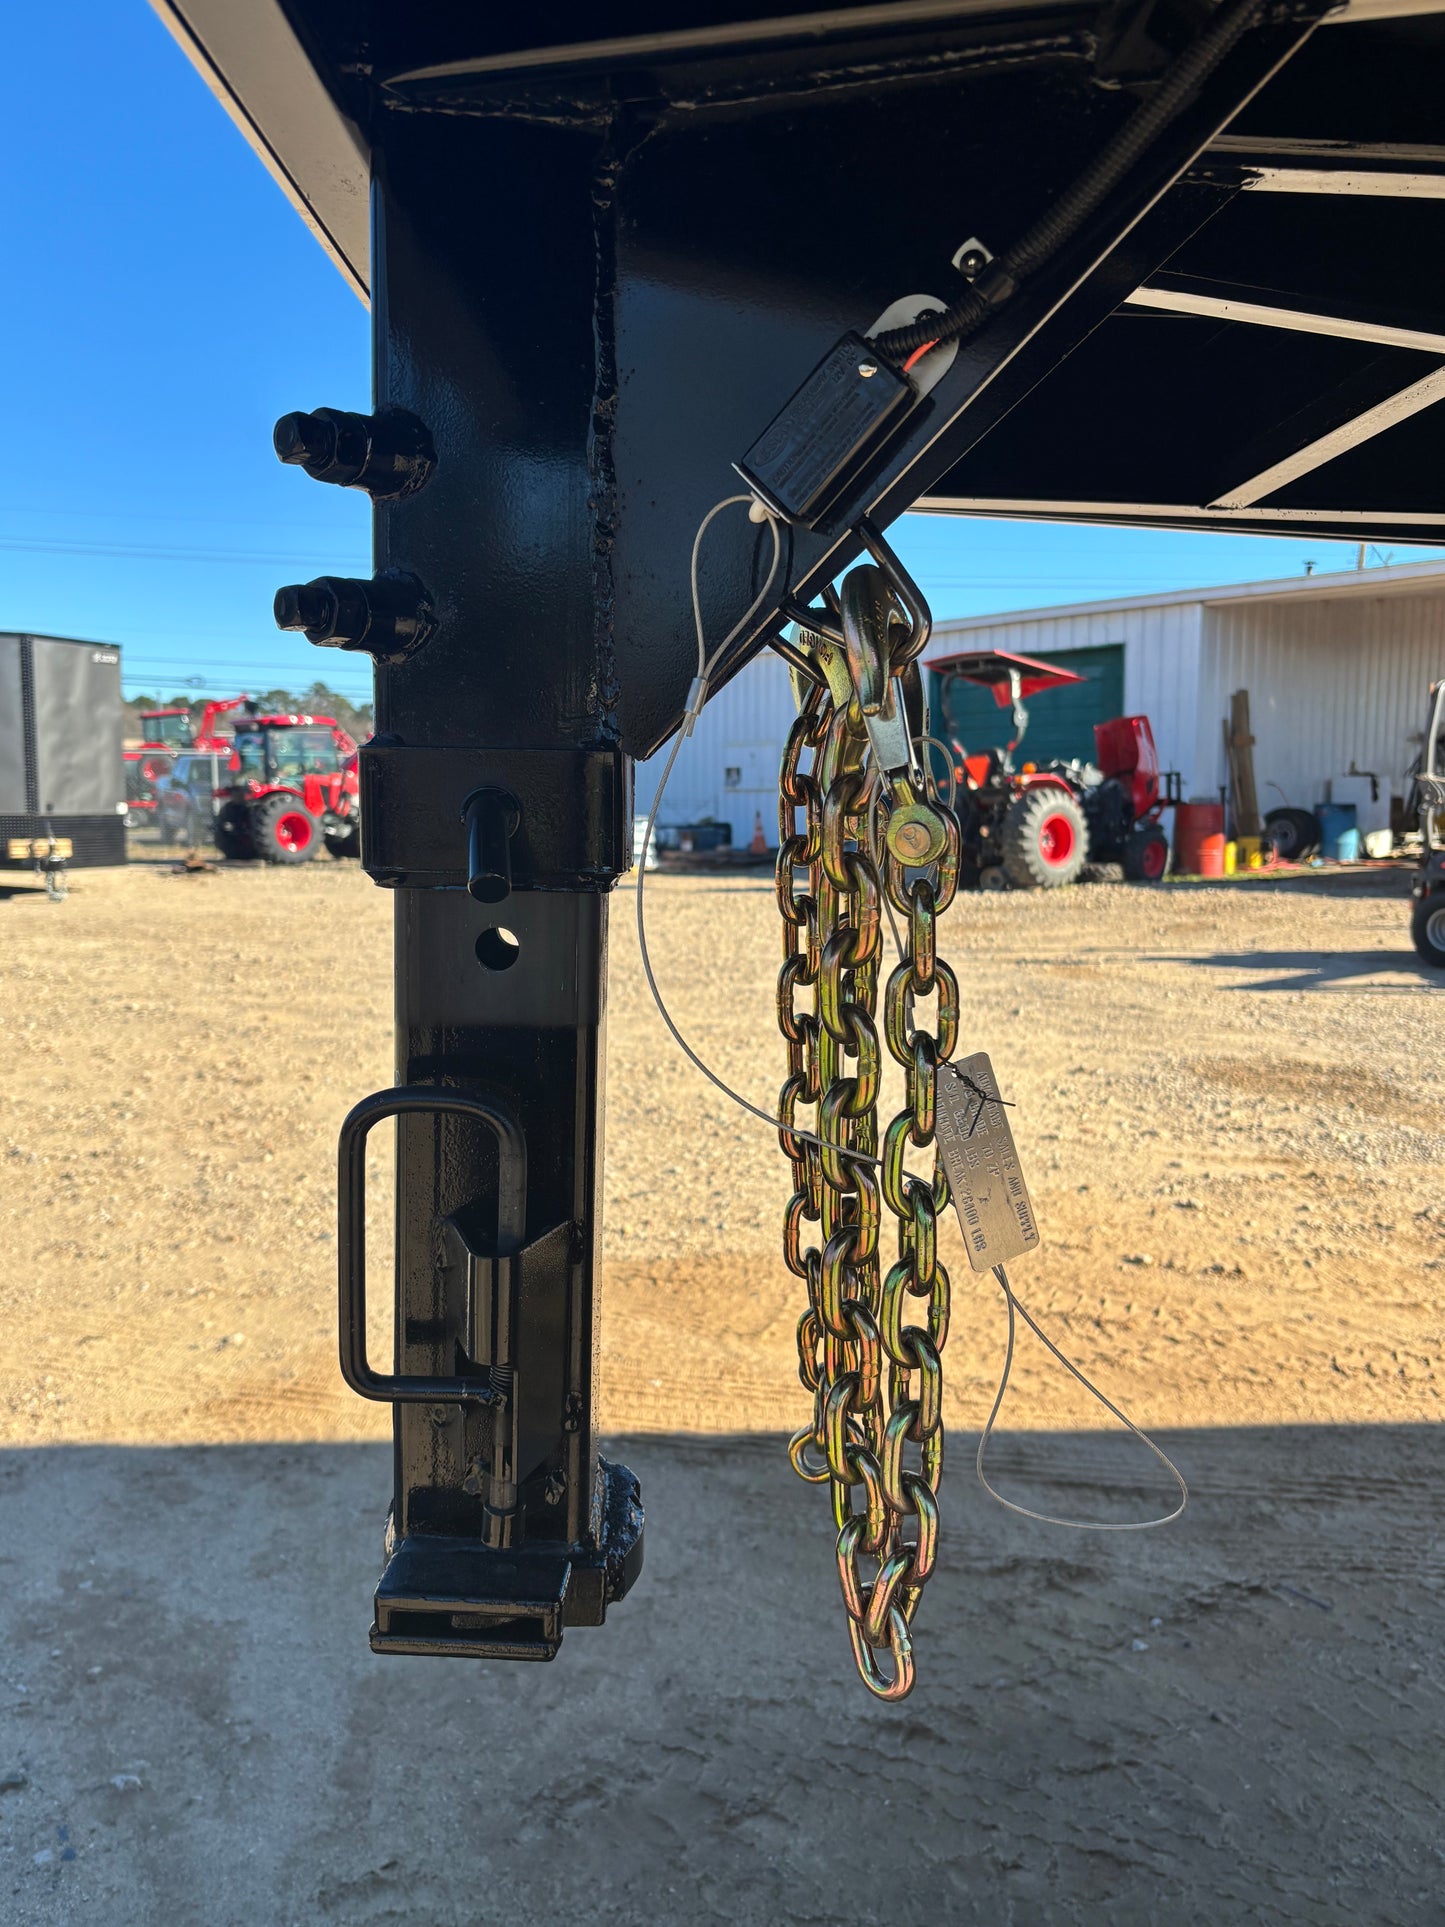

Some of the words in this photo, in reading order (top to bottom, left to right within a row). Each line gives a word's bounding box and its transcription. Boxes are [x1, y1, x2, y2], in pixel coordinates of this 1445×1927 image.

[963, 1146, 979, 1169] LBS
[996, 1136, 1015, 1170] SALES
[1007, 1175, 1023, 1197] AND
[1013, 1200, 1035, 1242] SUPPLY
[969, 1227, 987, 1252] LBS
